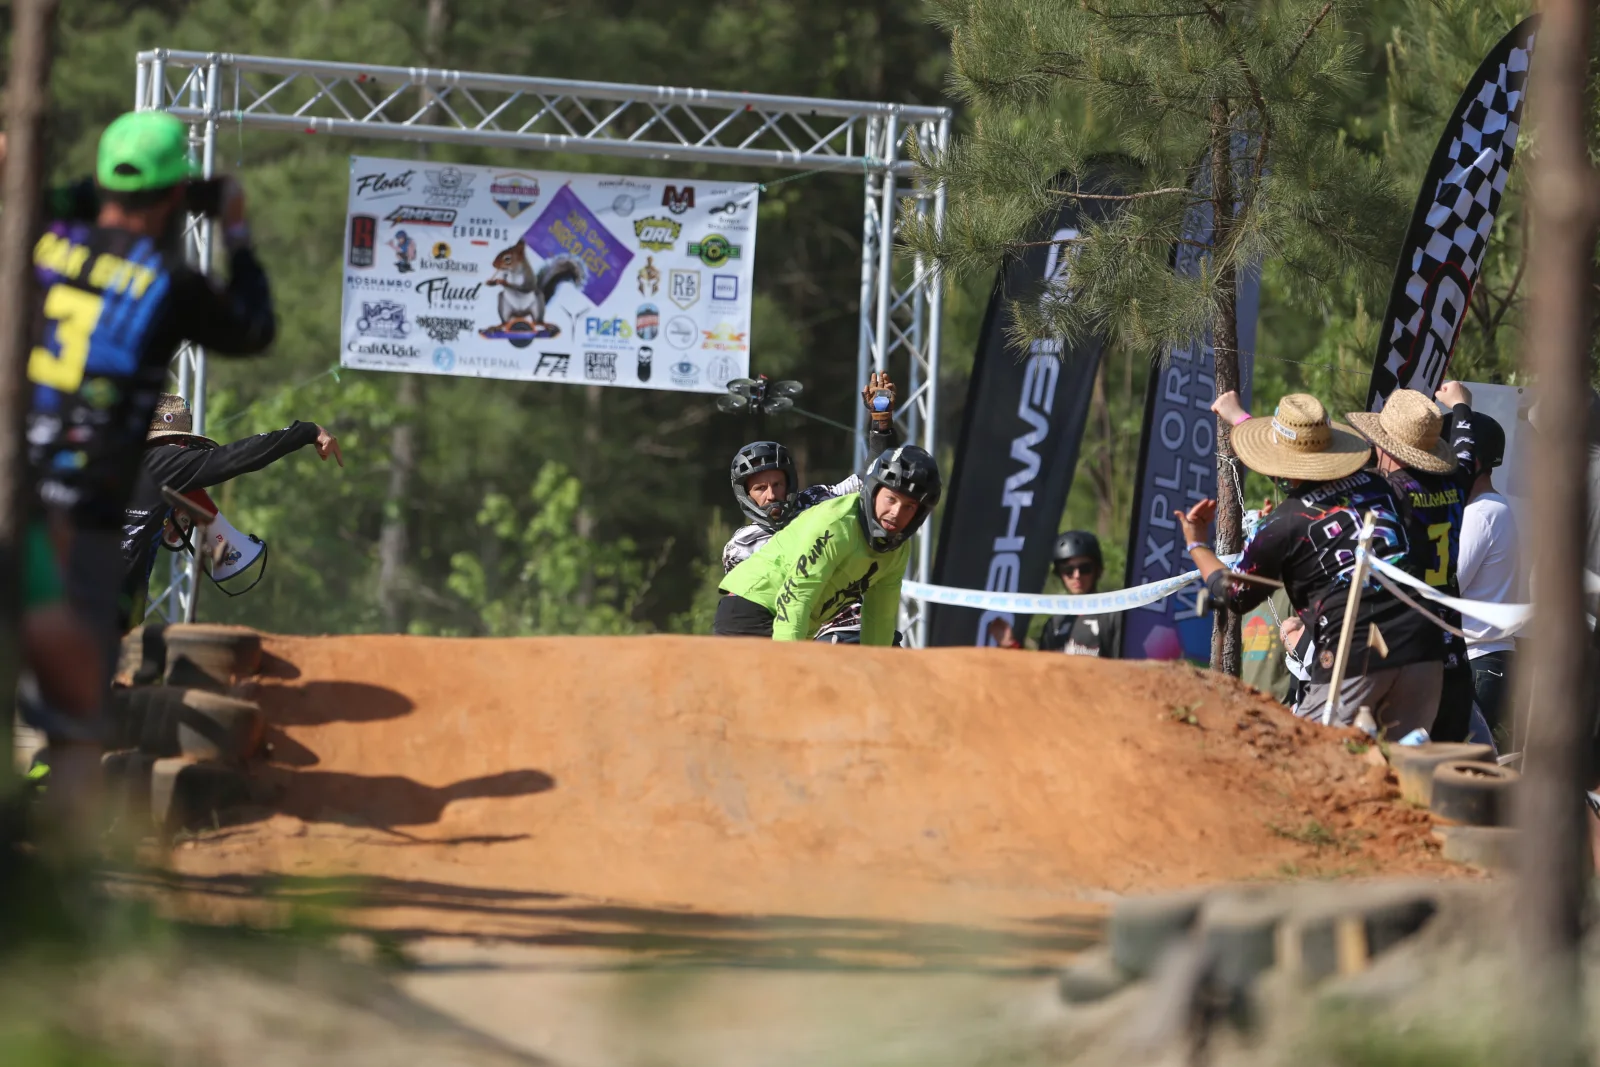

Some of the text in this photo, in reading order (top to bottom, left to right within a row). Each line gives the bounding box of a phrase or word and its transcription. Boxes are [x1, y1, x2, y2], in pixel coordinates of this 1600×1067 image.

[357, 169, 416, 196] Float
[392, 208, 455, 223] AMPED
[470, 217, 493, 225] RENT
[453, 226, 508, 241] EBOARDS
[347, 276, 413, 288] ROSHAMBO
[415, 277, 483, 305] Fluid
[27, 283, 103, 393] 3
[347, 341, 422, 358] Craft&Ride
